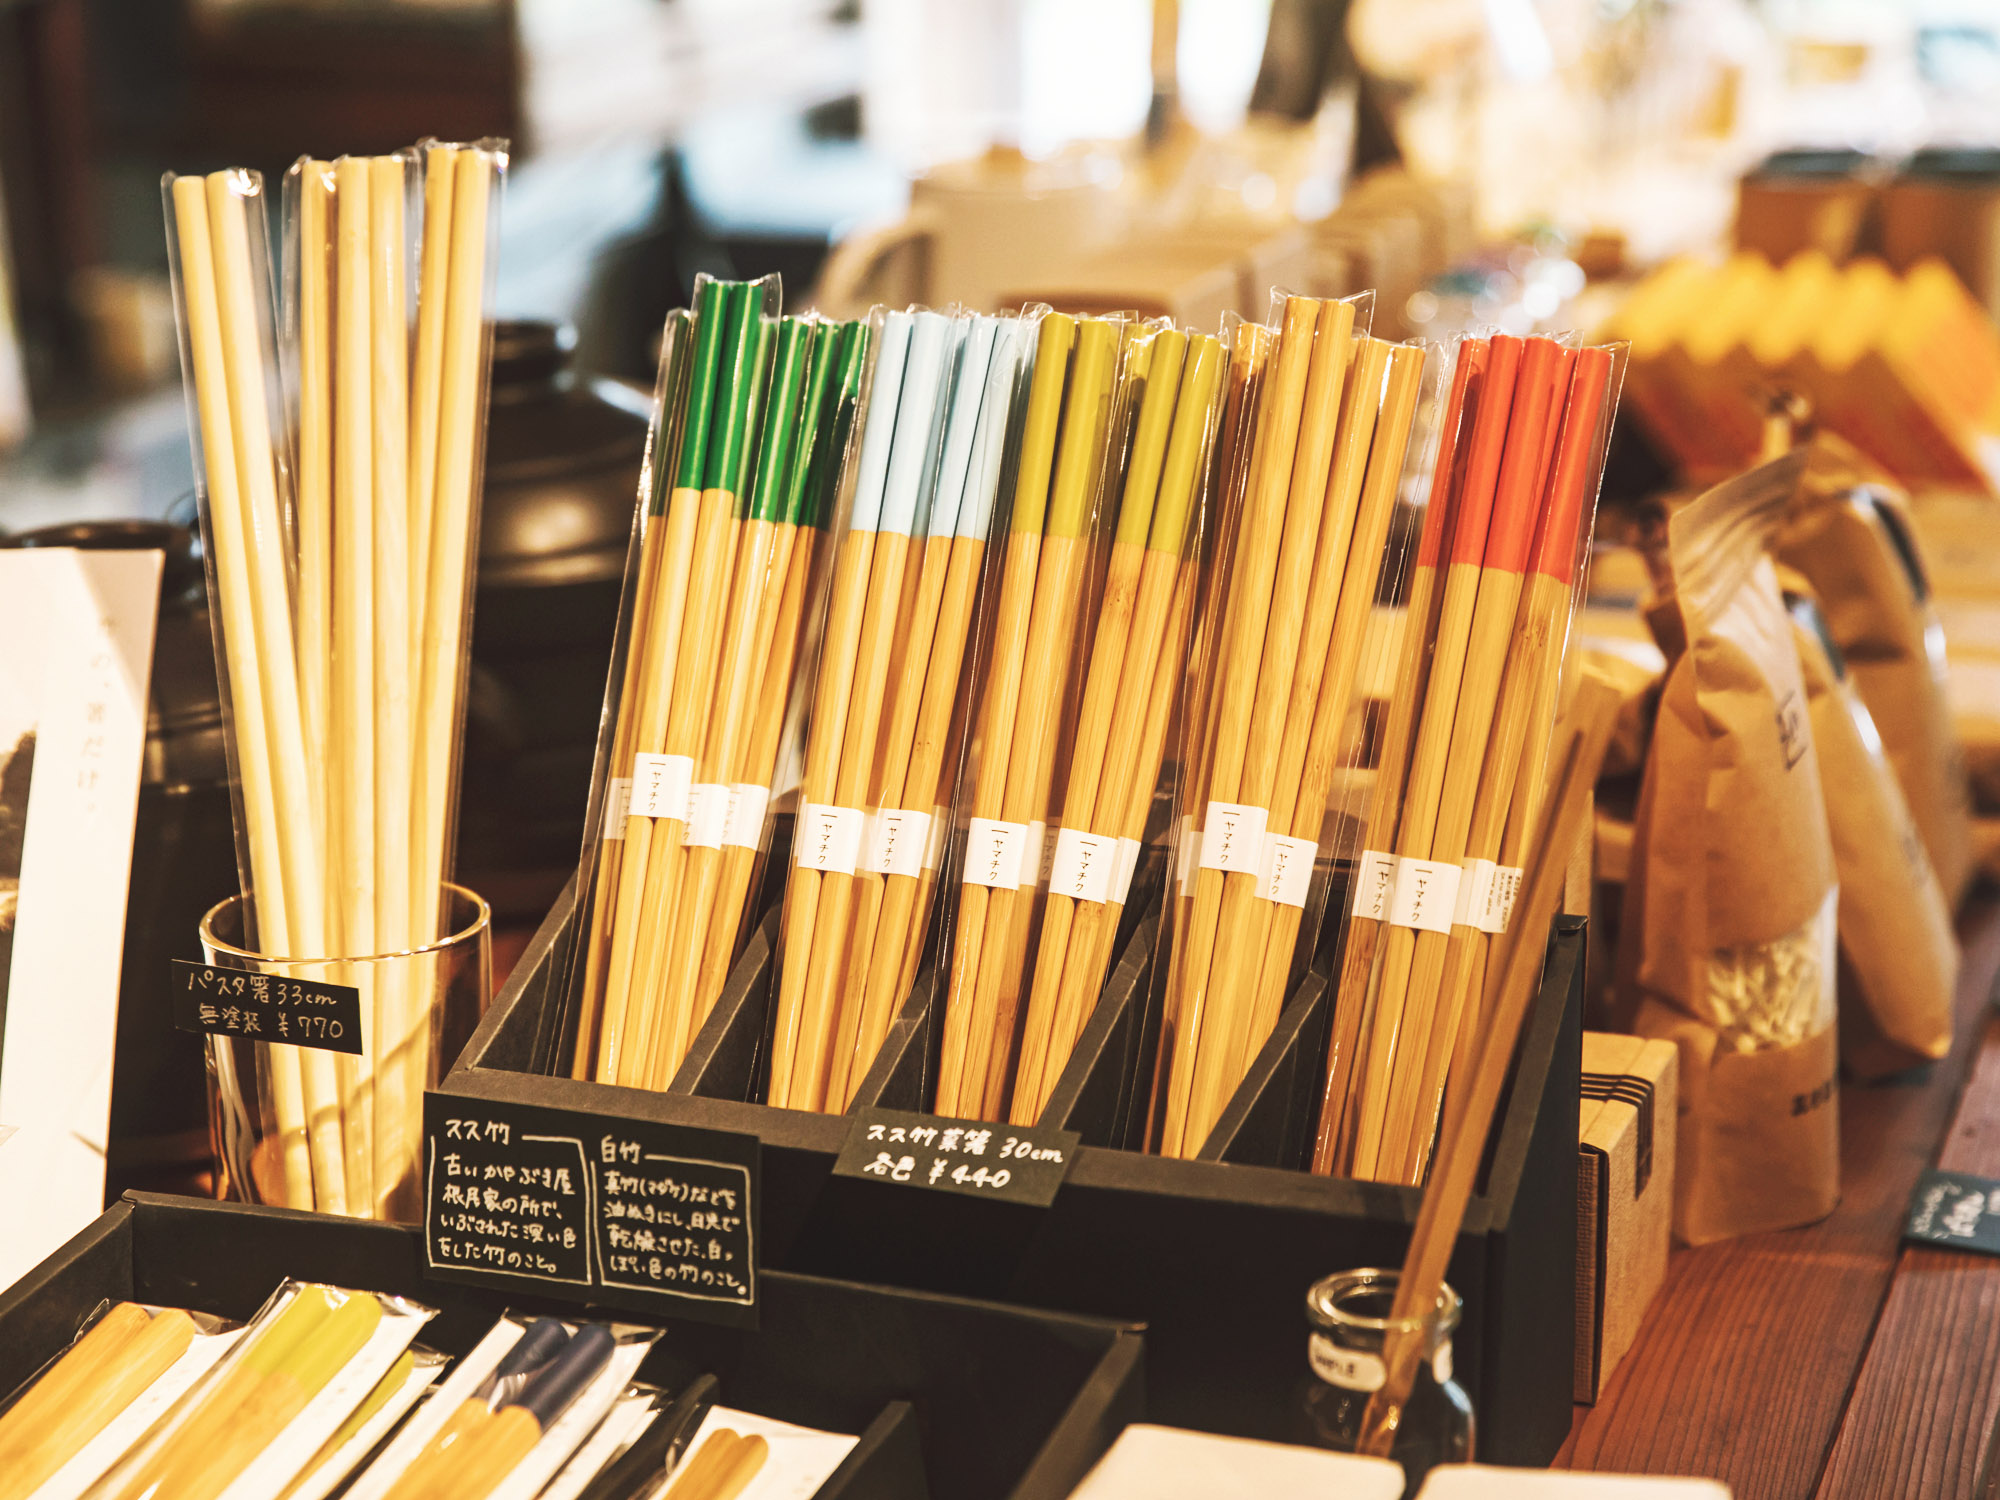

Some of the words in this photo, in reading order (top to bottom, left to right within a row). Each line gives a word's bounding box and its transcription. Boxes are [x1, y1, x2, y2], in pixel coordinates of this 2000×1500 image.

[187, 968, 271, 1004] パスタ箸
[277, 982, 338, 1006] 33cm
[198, 1002, 262, 1034] 無塗装
[277, 1012, 344, 1039] ¥770
[445, 1119, 511, 1145] スス竹
[601, 1134, 641, 1165] 白竹
[999, 1136, 1065, 1164] 30cm
[863, 1151, 917, 1182] 各色
[928, 1156, 1012, 1189] ¥440
